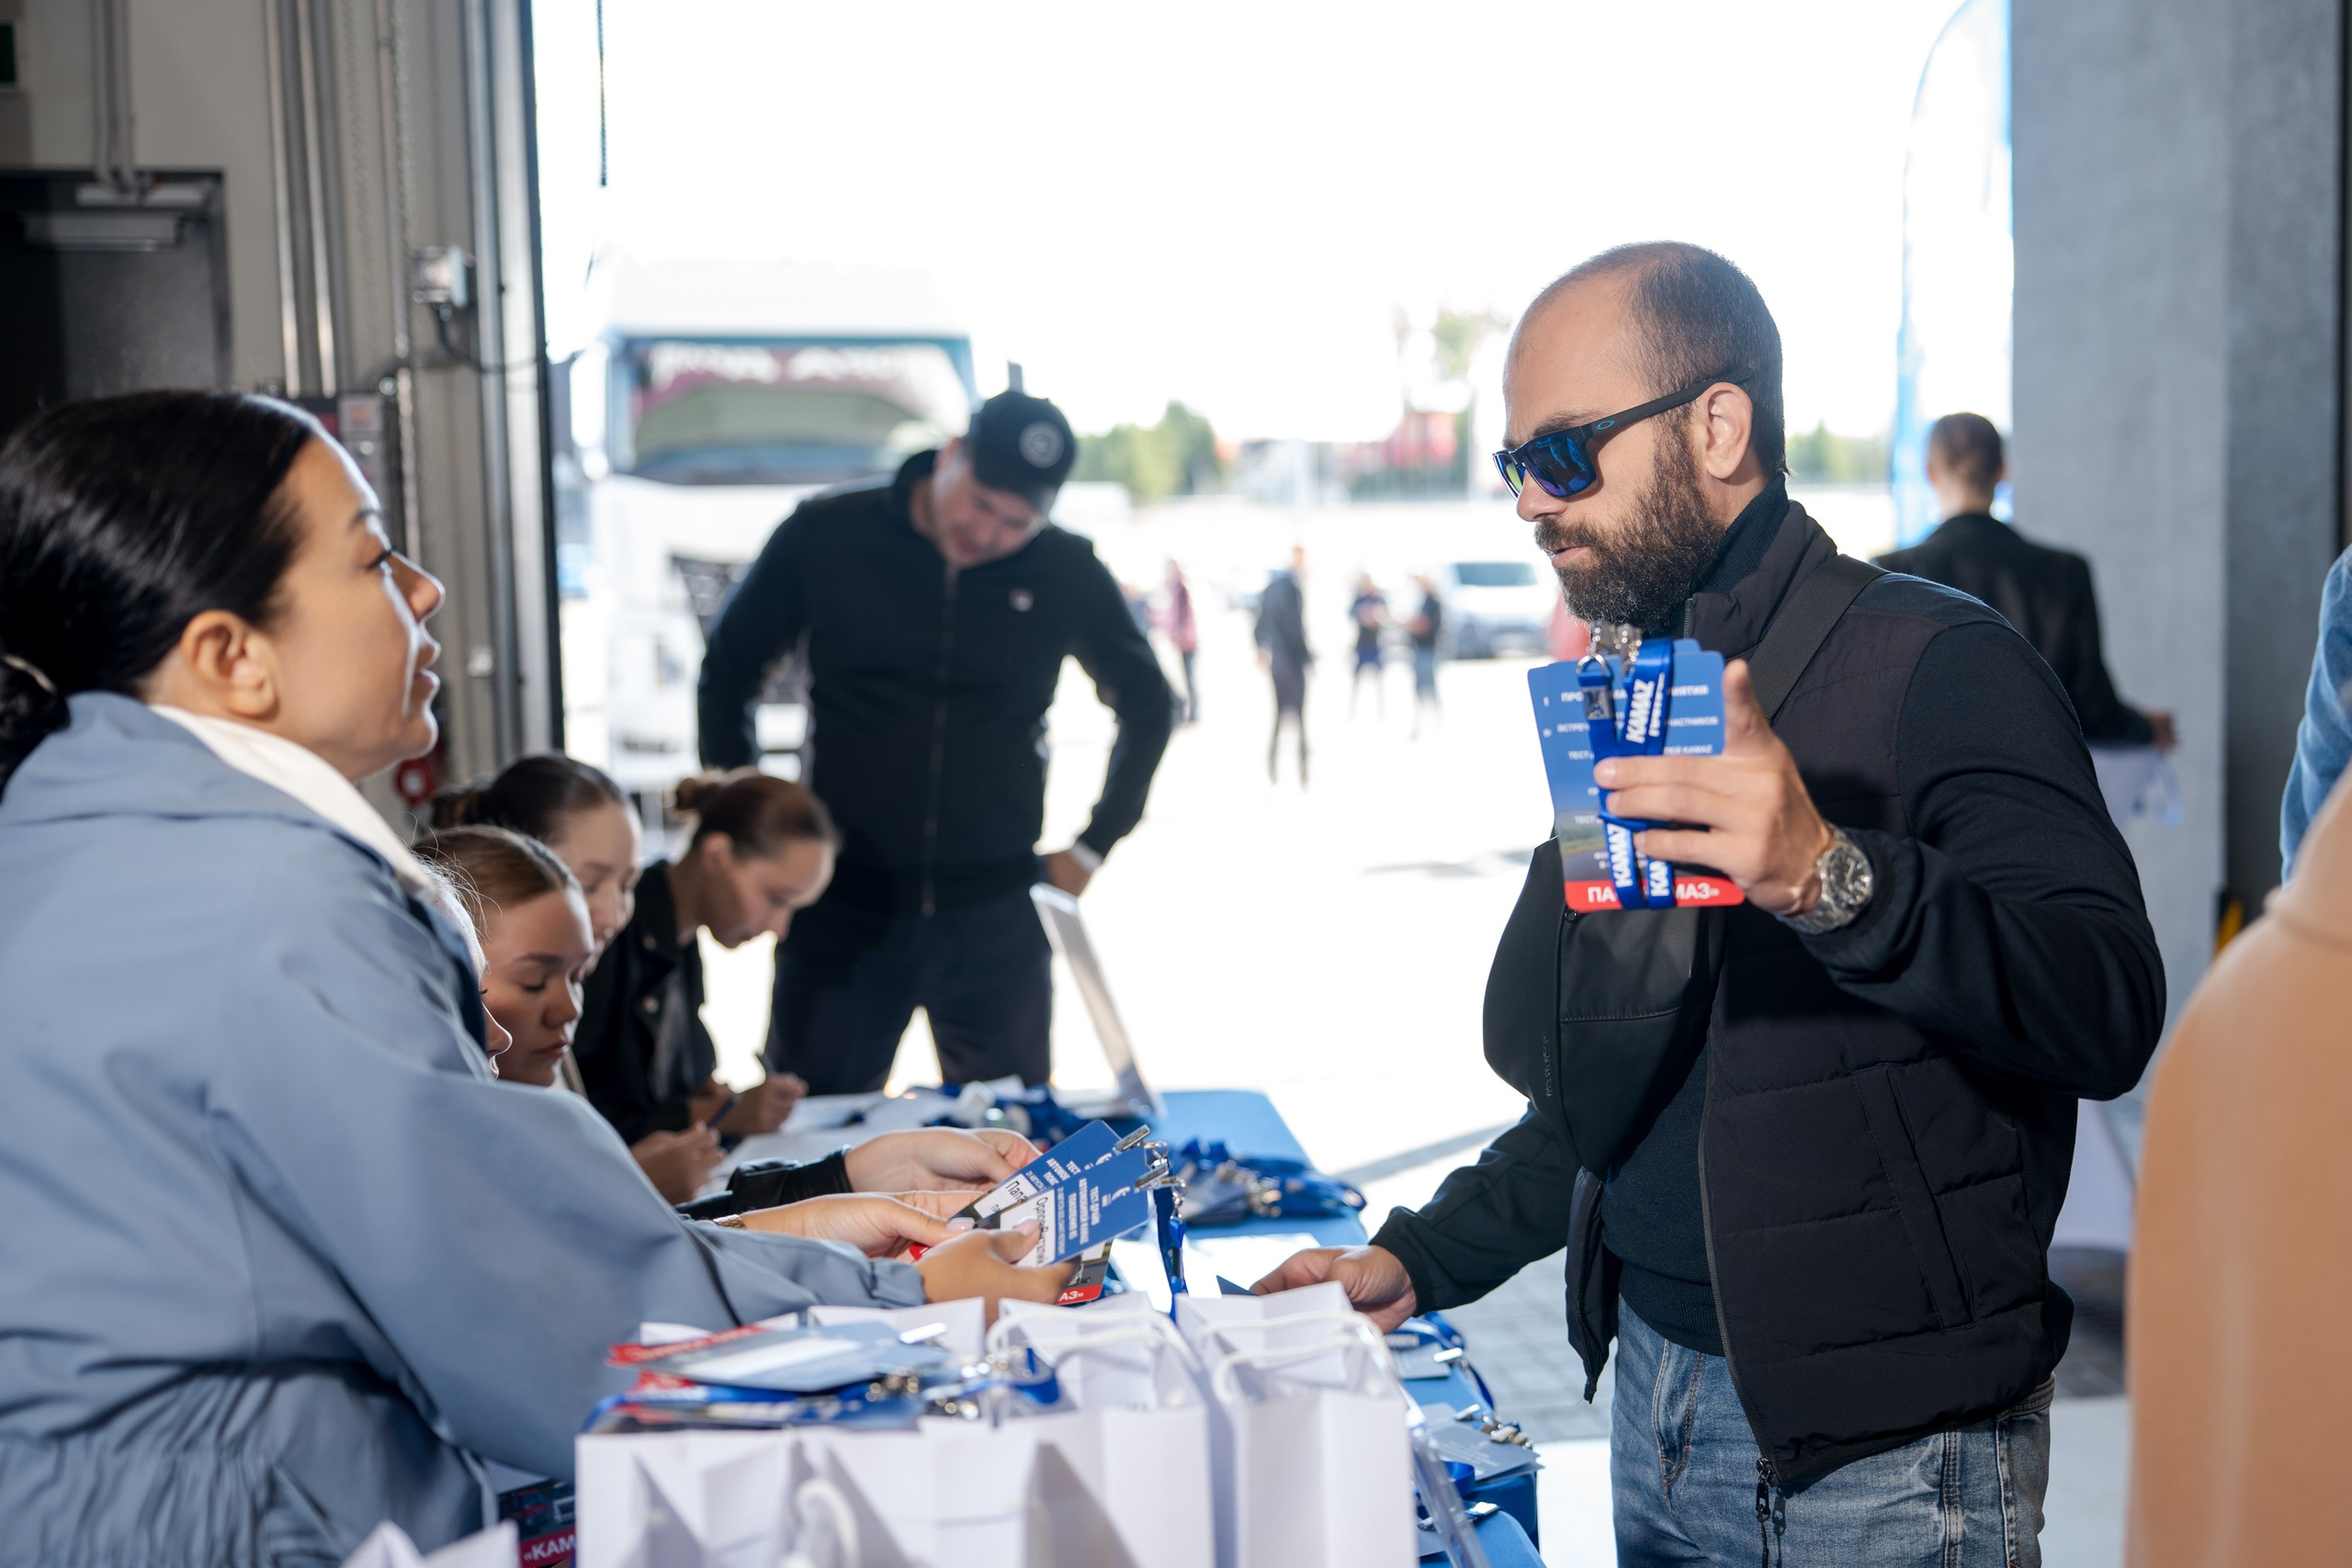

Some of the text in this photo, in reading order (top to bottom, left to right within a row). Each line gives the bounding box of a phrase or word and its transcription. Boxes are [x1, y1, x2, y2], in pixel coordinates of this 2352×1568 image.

[1625, 678, 1656, 744] KAMAZ
[1606, 822, 1634, 888] KAMAZ
[1587, 886, 1618, 903] ПА
[1058, 1290, 1084, 1303] АЗ»
[524, 1533, 576, 1562] «КАМ
